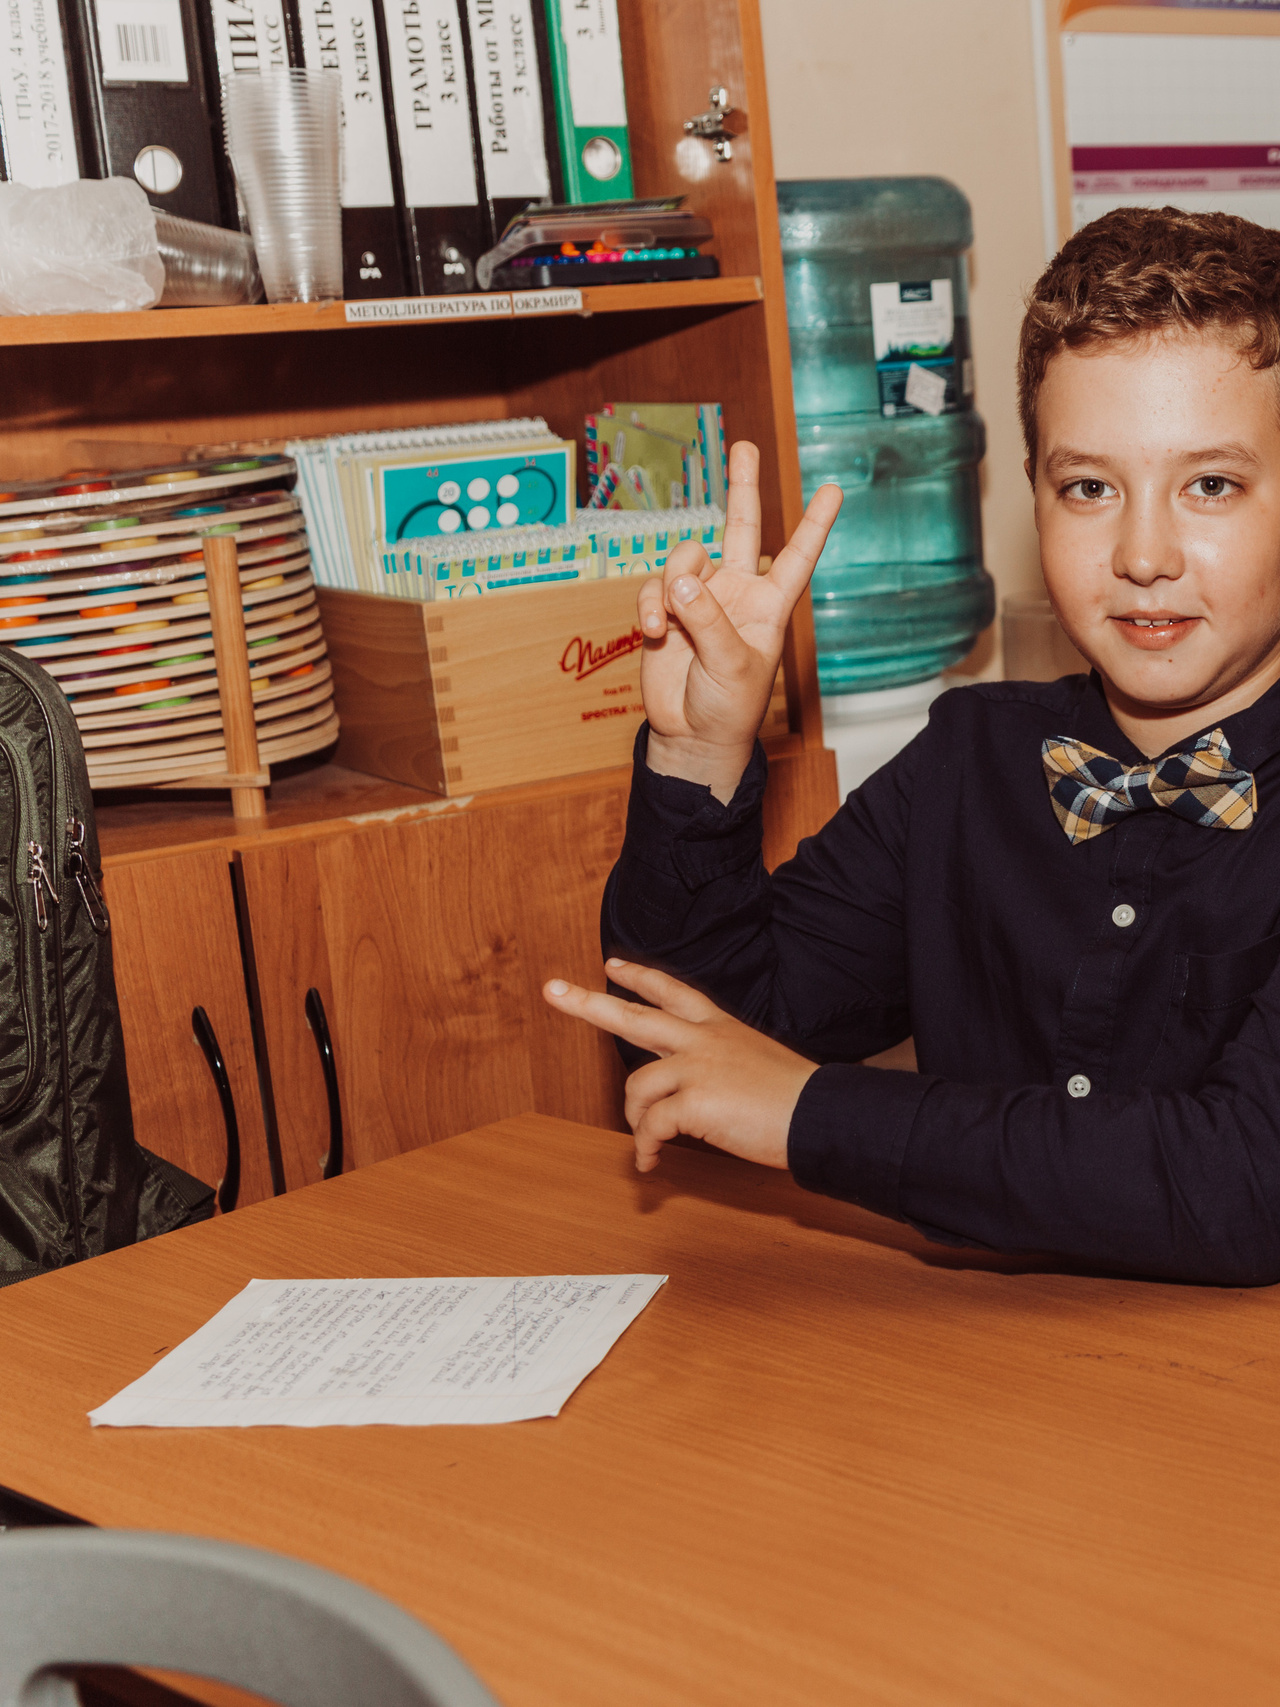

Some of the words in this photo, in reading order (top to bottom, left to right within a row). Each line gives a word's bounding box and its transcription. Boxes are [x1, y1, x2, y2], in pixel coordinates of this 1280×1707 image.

[351, 16, 370, 82] класс
[437, 18, 456, 83] класс
[485, 40, 499, 63] от
[510, 13, 527, 77] класс
[355, 91, 373, 103] 3
[440, 92, 458, 104] 3
[488, 70, 509, 154] Работы
[512, 85, 530, 97] 3
[39, 71, 63, 161] 2017-2018
[490, 298, 510, 311] ПО
[559, 625, 643, 673] Палитр
